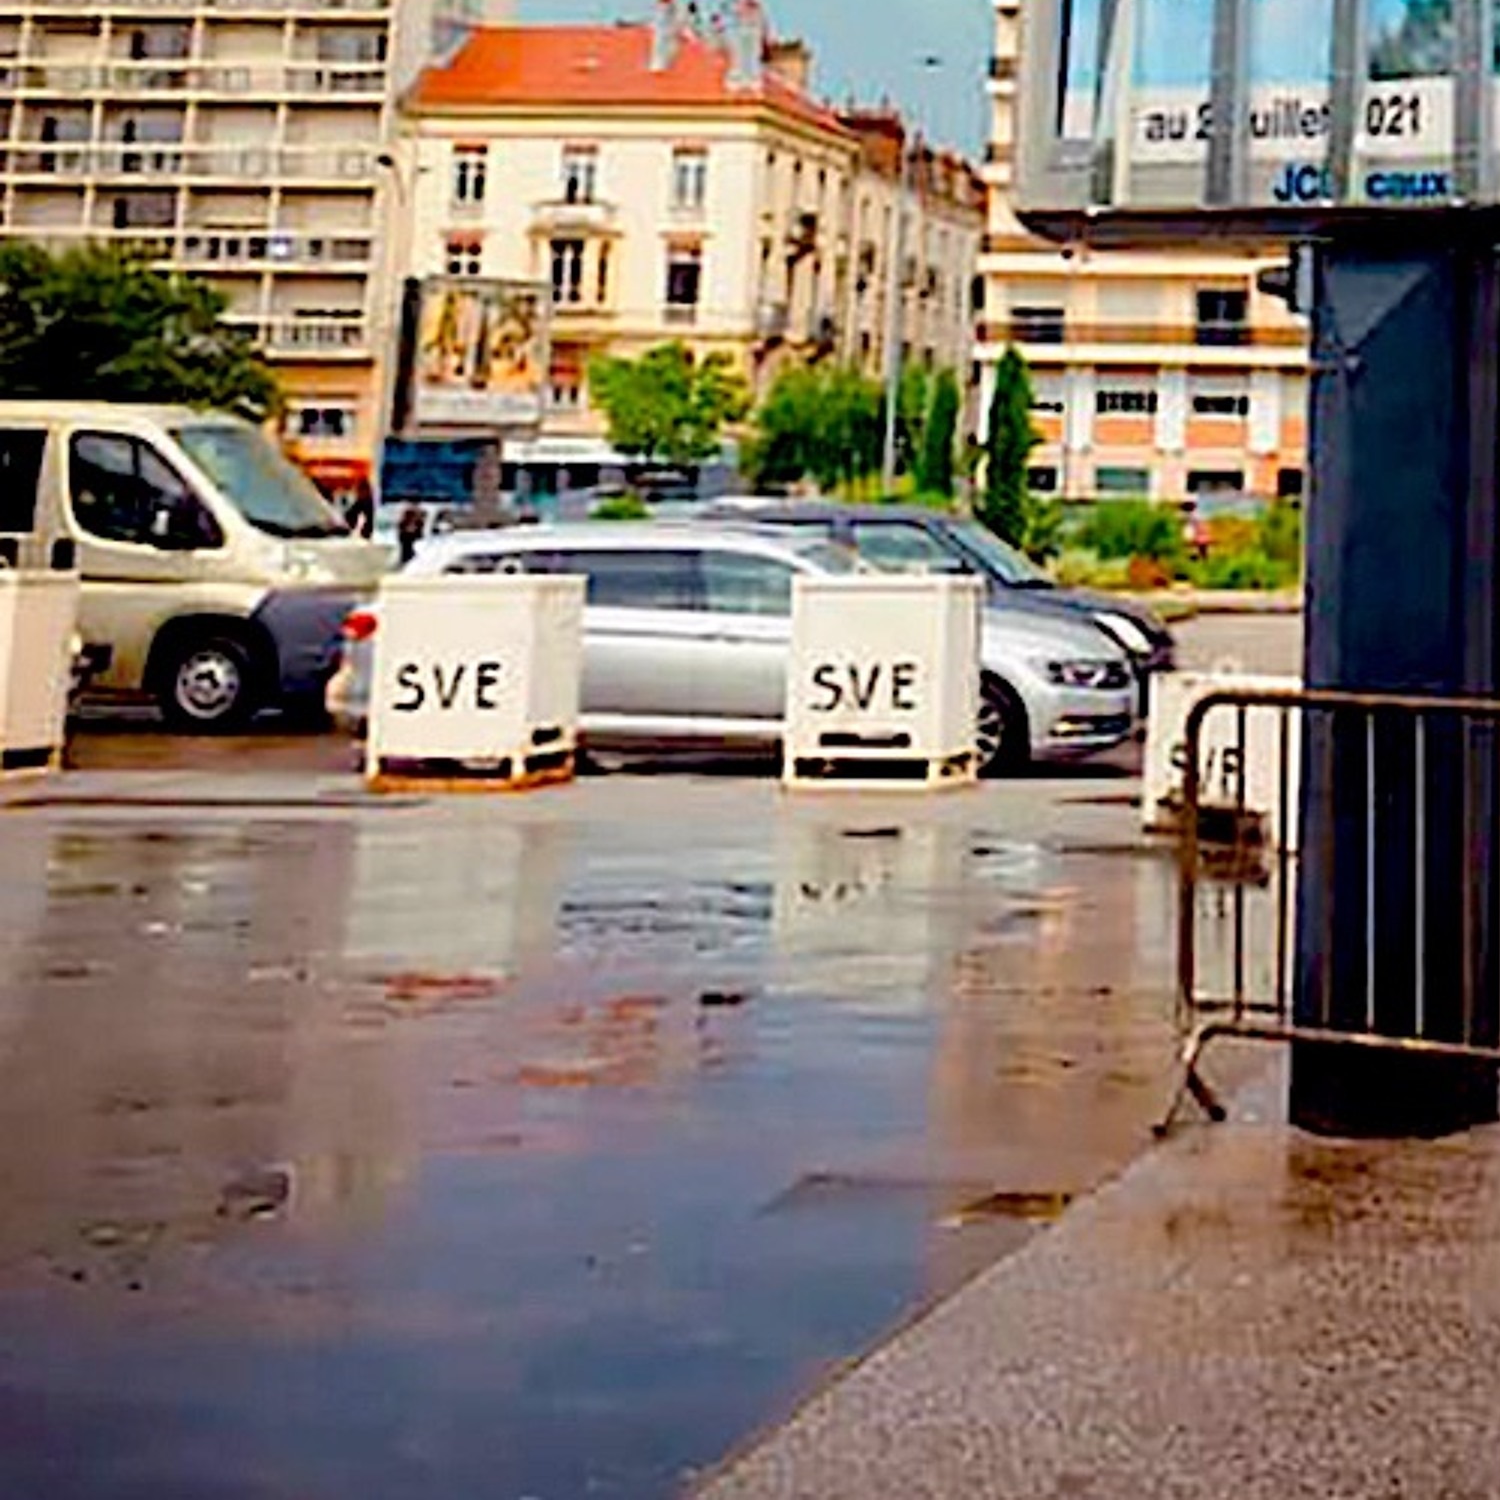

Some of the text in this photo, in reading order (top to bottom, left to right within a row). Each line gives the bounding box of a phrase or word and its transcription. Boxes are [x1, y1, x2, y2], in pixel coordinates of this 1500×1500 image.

[1365, 94, 1423, 137] 021
[392, 662, 501, 711] SVE
[809, 663, 917, 712] SVE
